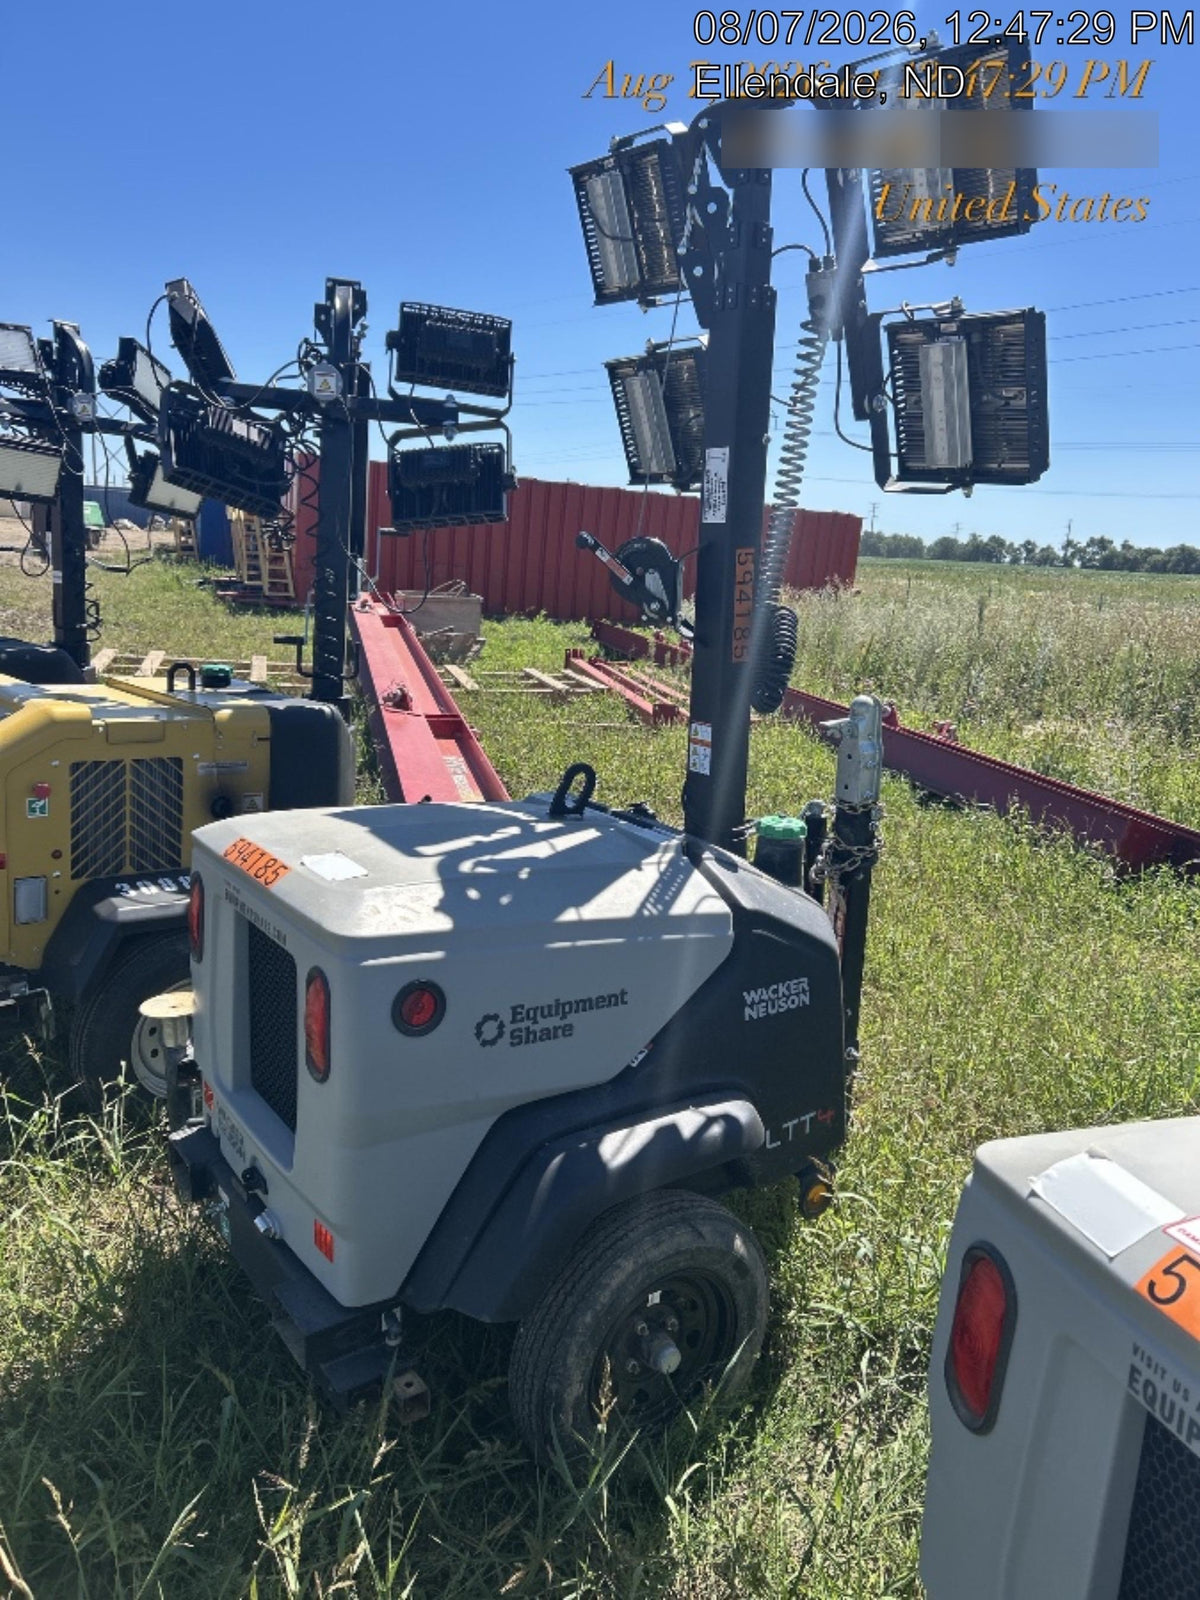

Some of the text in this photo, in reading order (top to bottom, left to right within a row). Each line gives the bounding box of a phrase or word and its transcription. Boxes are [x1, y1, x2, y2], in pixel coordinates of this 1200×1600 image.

[734, 552, 754, 659] 594185
[223, 838, 289, 886] 594185
[510, 988, 629, 1025] Equipment
[742, 977, 810, 1005] WACKER
[744, 992, 810, 1021] NEUSON
[510, 1022, 574, 1048] Share
[765, 1109, 835, 1149] LTT4
[1132, 1342, 1190, 1402] VISIT US
